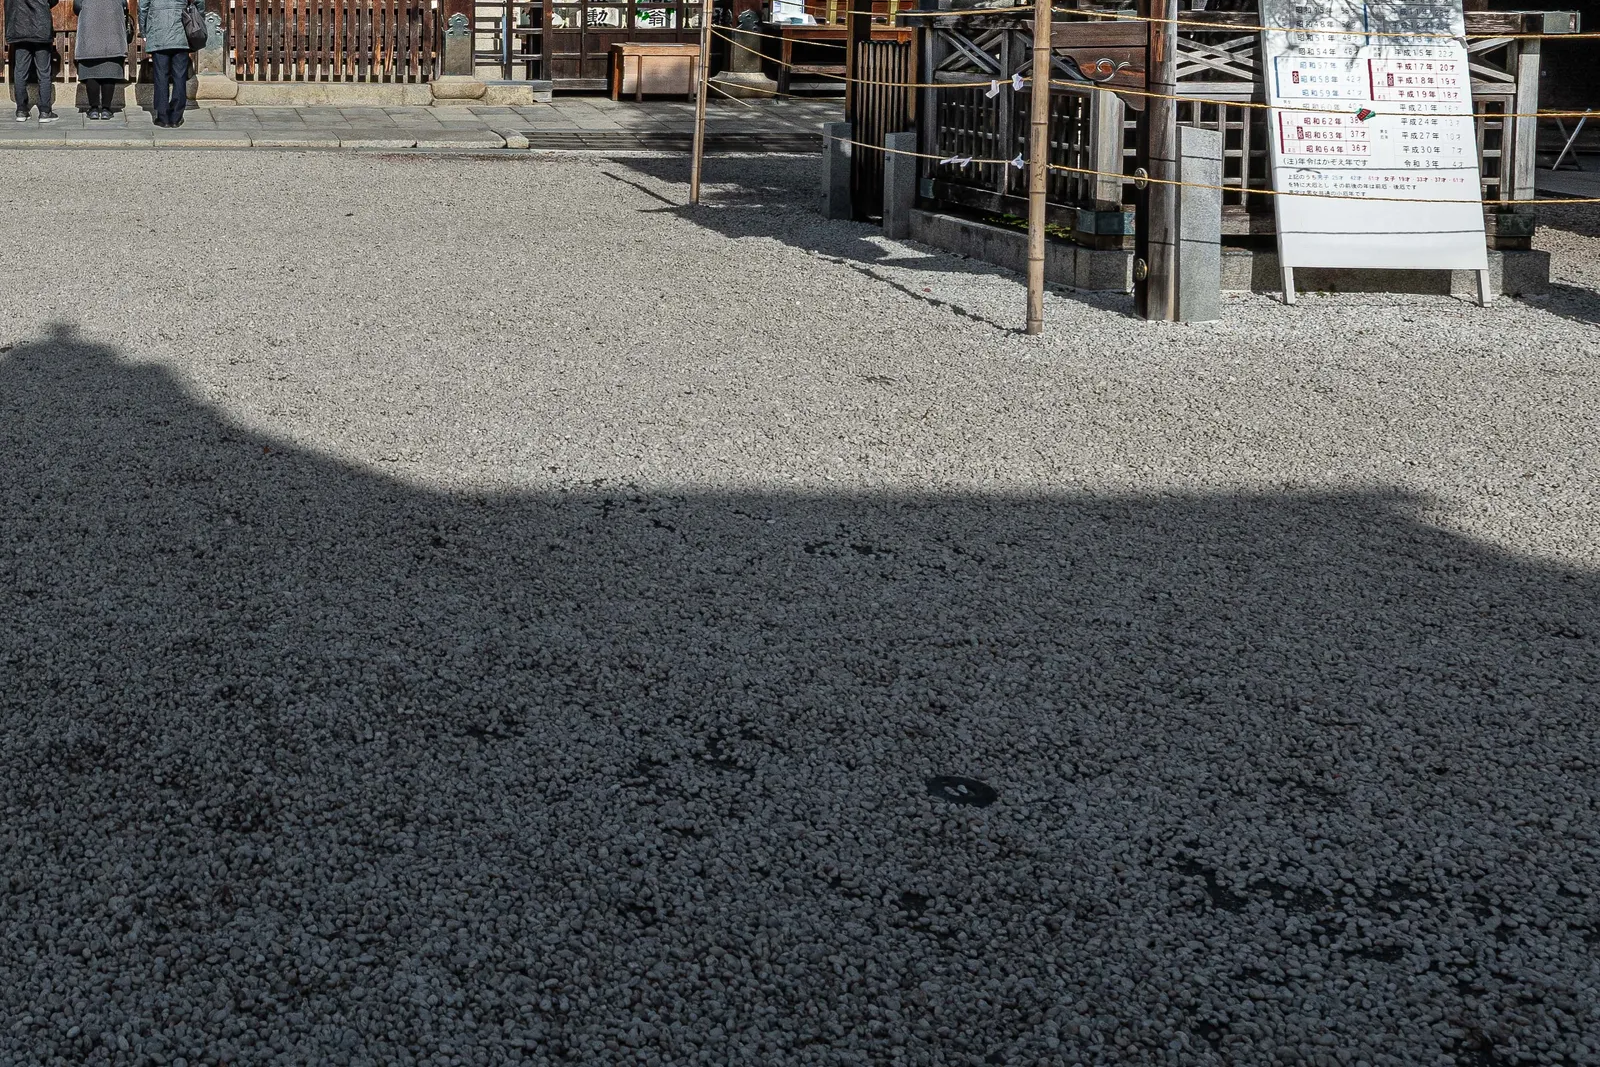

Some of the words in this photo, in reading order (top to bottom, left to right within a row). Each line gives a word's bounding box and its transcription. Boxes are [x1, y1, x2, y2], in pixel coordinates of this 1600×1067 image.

[1299, 47, 1336, 55] 昭和54年
[1395, 49, 1433, 57] 平成15年
[1440, 64, 1455, 72] 20才
[1301, 75, 1338, 83] 昭和58年
[1397, 76, 1435, 84] 平成18年
[1441, 78, 1456, 86] 19才
[1302, 89, 1339, 97] 昭和59年
[1398, 90, 1436, 98] 平成19年
[1442, 91, 1458, 99] 18才
[1400, 103, 1437, 112] 平成21年
[1303, 117, 1342, 125] 昭和62年
[1401, 117, 1438, 125] 平成24年
[1305, 131, 1342, 139] 昭和63年
[1350, 130, 1366, 138] 37才
[1402, 131, 1439, 140] 平成27年
[1306, 145, 1343, 153] 昭和64年
[1351, 144, 1367, 152] 36才
[1403, 145, 1440, 154] 平成30年
